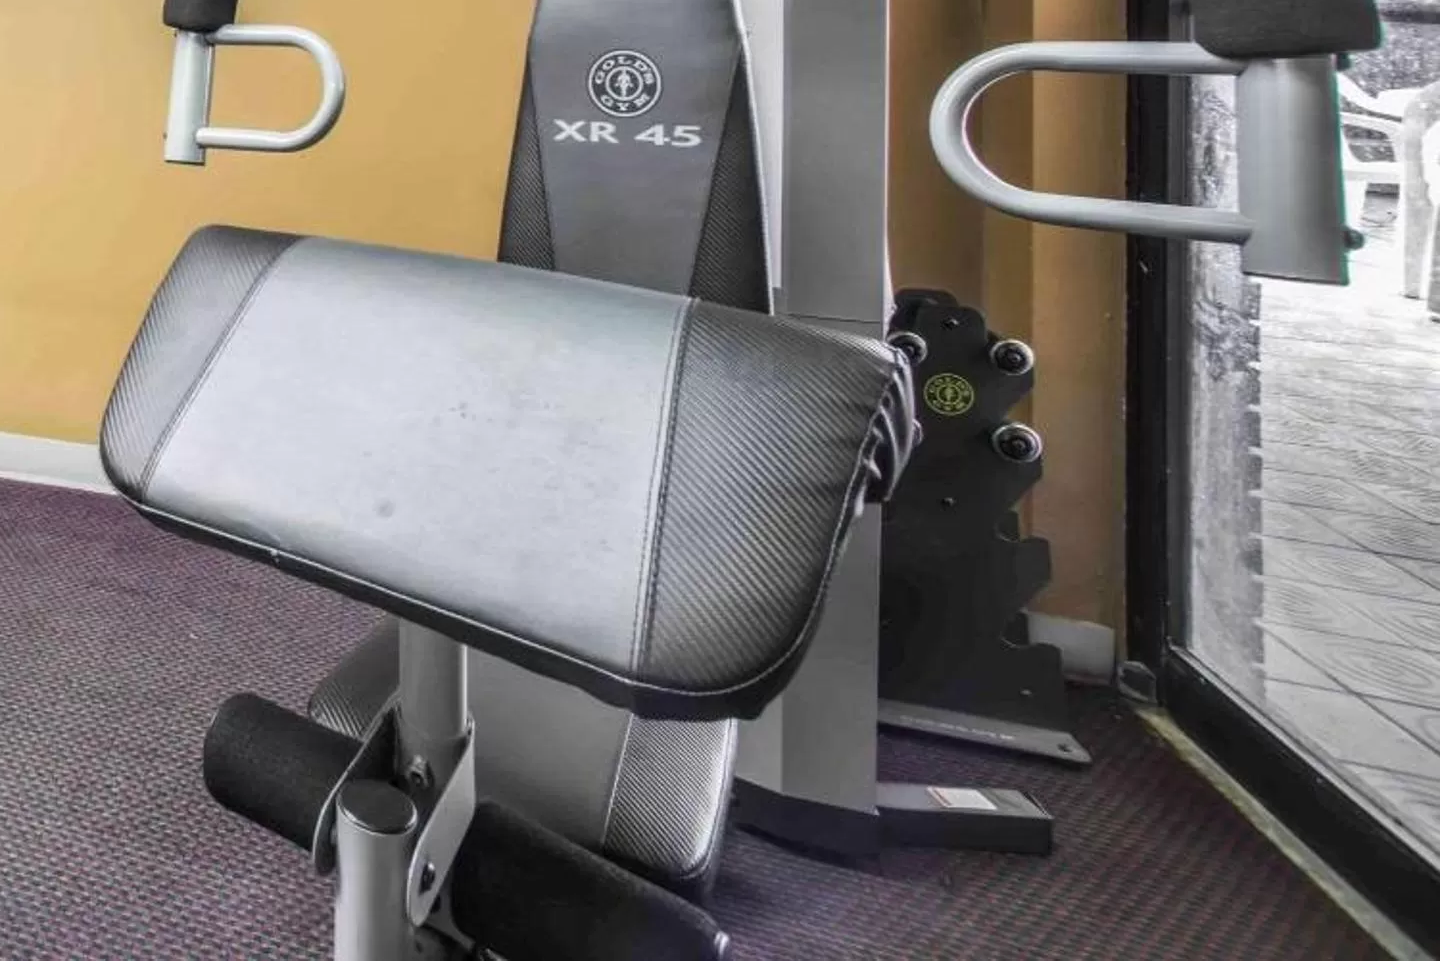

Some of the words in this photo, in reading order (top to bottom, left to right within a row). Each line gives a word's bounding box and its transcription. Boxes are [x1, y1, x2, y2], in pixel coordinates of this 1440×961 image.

[601, 92, 650, 111] GYM
[553, 118, 620, 143] XR
[633, 124, 703, 147] 45
